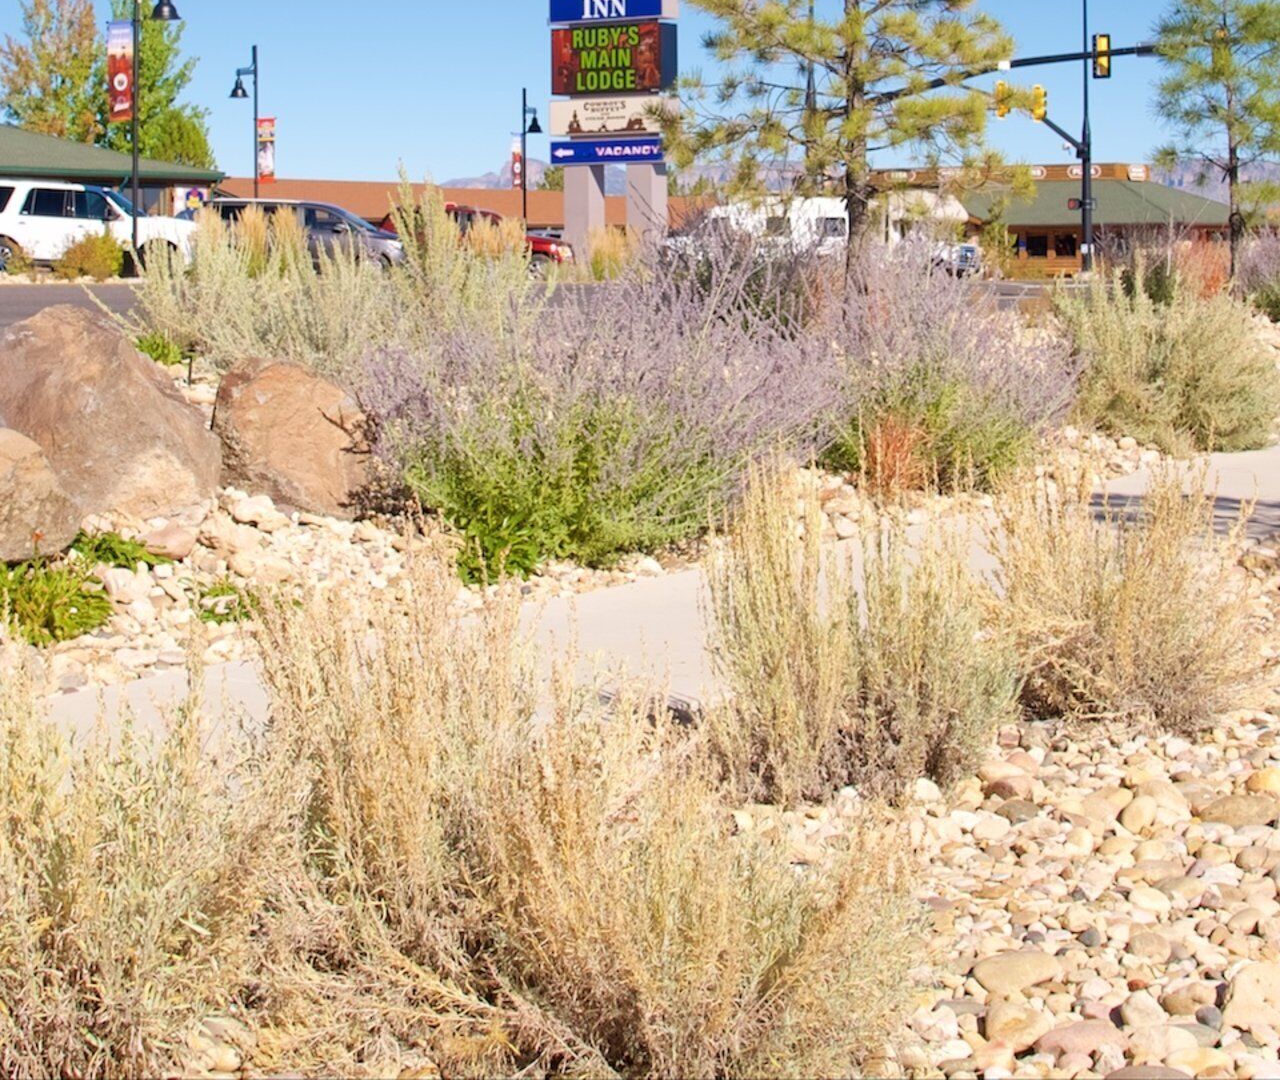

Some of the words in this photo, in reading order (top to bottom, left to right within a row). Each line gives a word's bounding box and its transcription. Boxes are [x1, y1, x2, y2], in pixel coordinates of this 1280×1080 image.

[572, 25, 639, 49] RUBY'S
[581, 48, 632, 69] MAIN
[577, 69, 636, 91] LODGE
[595, 145, 660, 157] VACANCY
